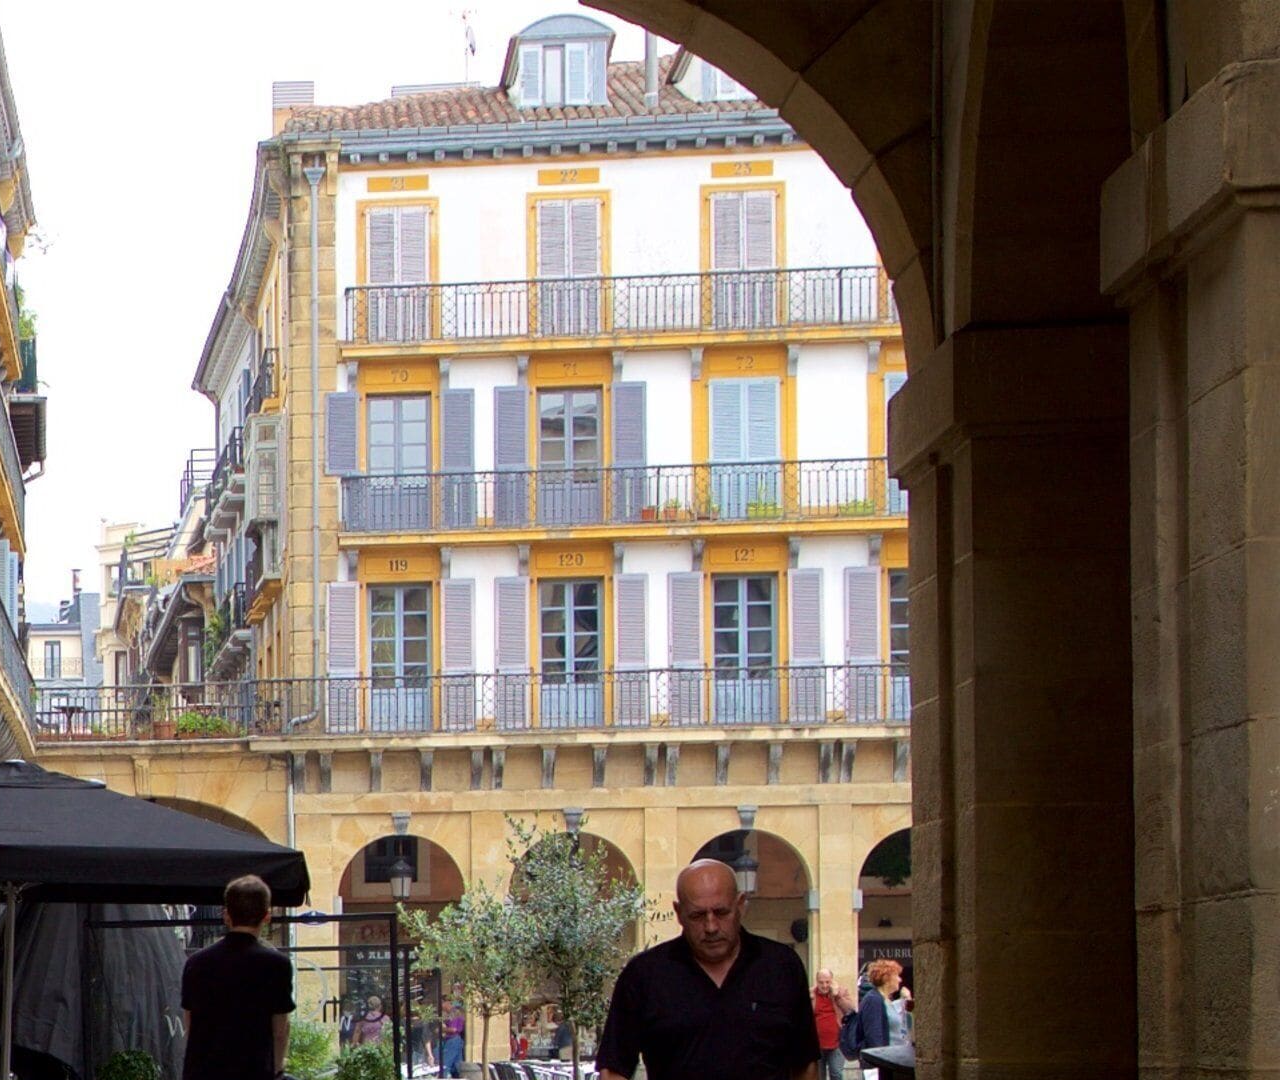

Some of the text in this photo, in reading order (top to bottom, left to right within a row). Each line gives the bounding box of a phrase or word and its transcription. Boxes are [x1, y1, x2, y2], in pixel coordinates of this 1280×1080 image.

[561, 168, 578, 183] 22
[563, 361, 578, 377] 71
[735, 355, 754, 369] 72
[390, 368, 409, 383] 70
[559, 552, 584, 567] 120
[734, 548, 755, 562] 121
[389, 559, 408, 572] 119
